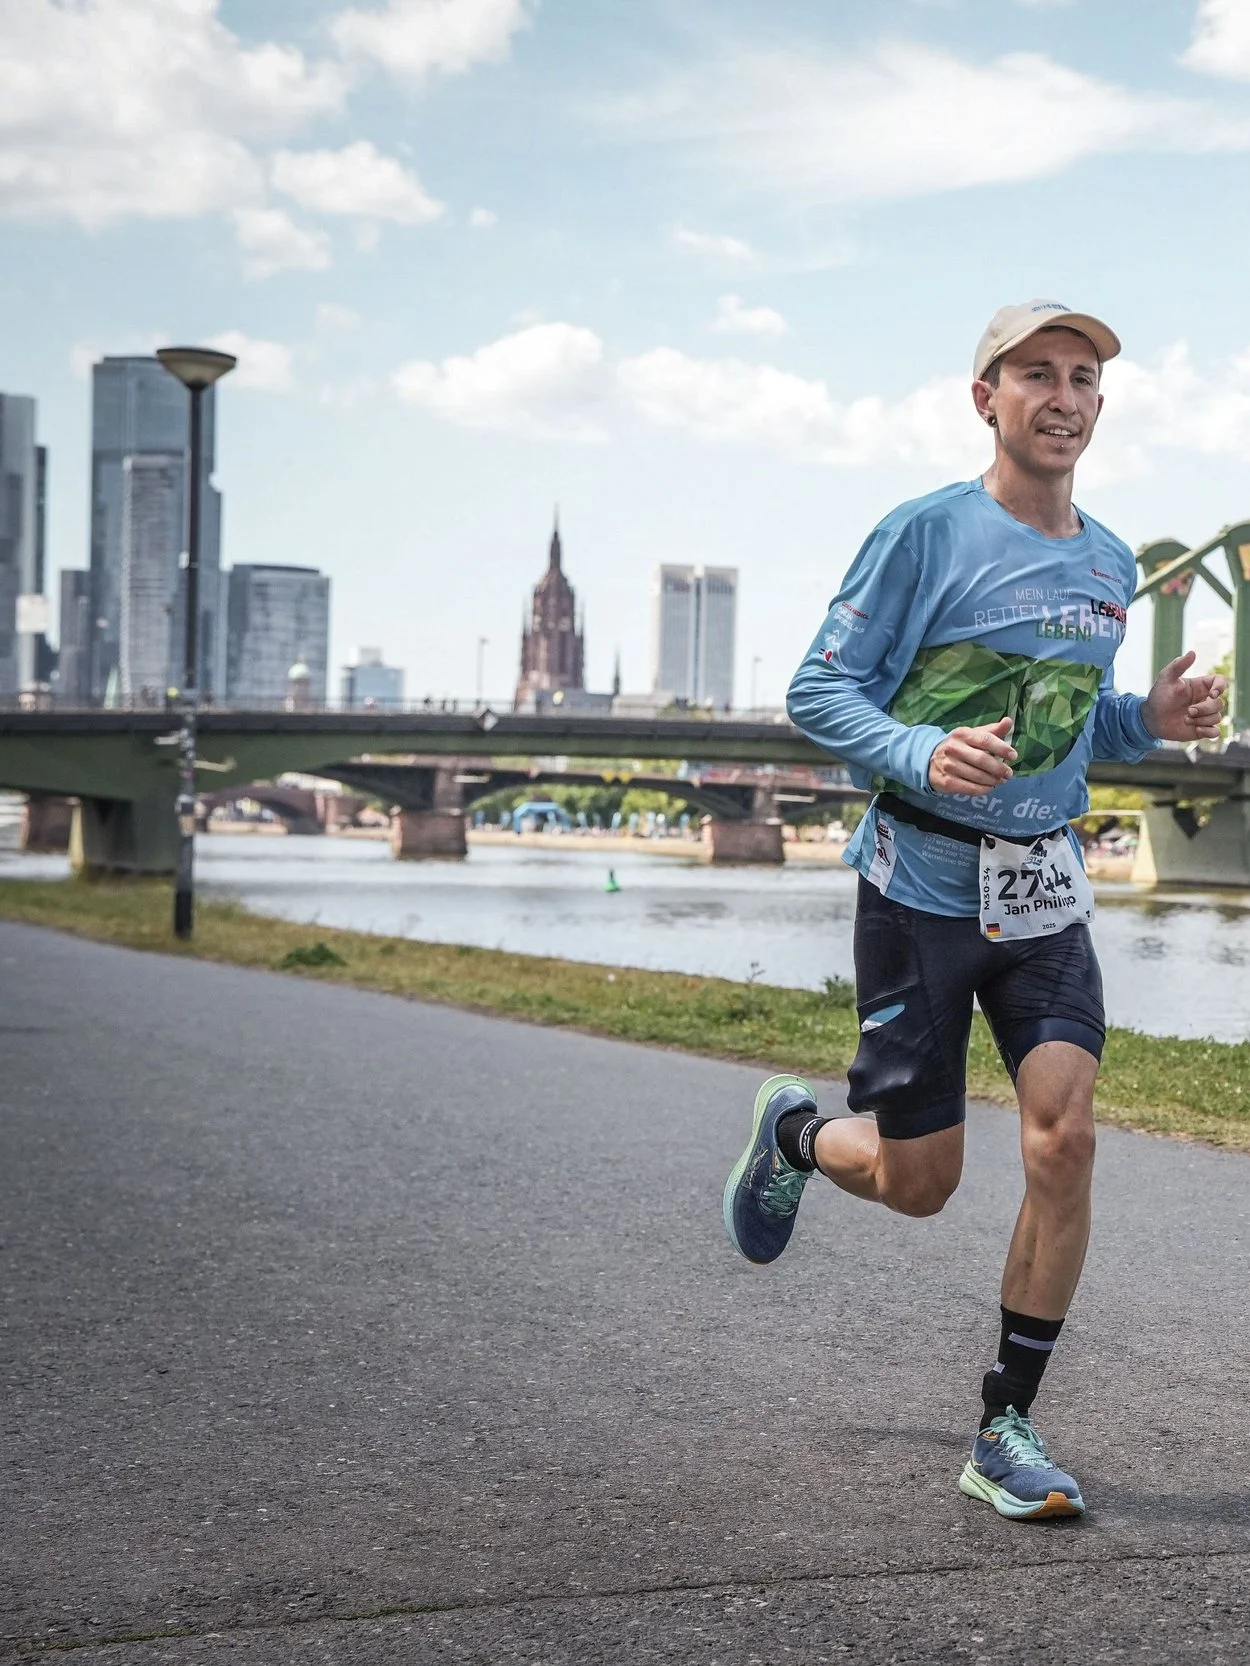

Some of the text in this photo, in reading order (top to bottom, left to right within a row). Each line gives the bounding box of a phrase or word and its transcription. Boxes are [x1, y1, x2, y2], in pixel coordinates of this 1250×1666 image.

[1015, 588, 1073, 601] MEIN LAUF
[974, 604, 1039, 628] RETTET
[1034, 622, 1092, 642] LEBEN!
[1012, 797, 1058, 820] die:
[997, 863, 1072, 901] 2744
[1004, 895, 1077, 916] Jan Philipp
[1042, 922, 1057, 930] 2025
